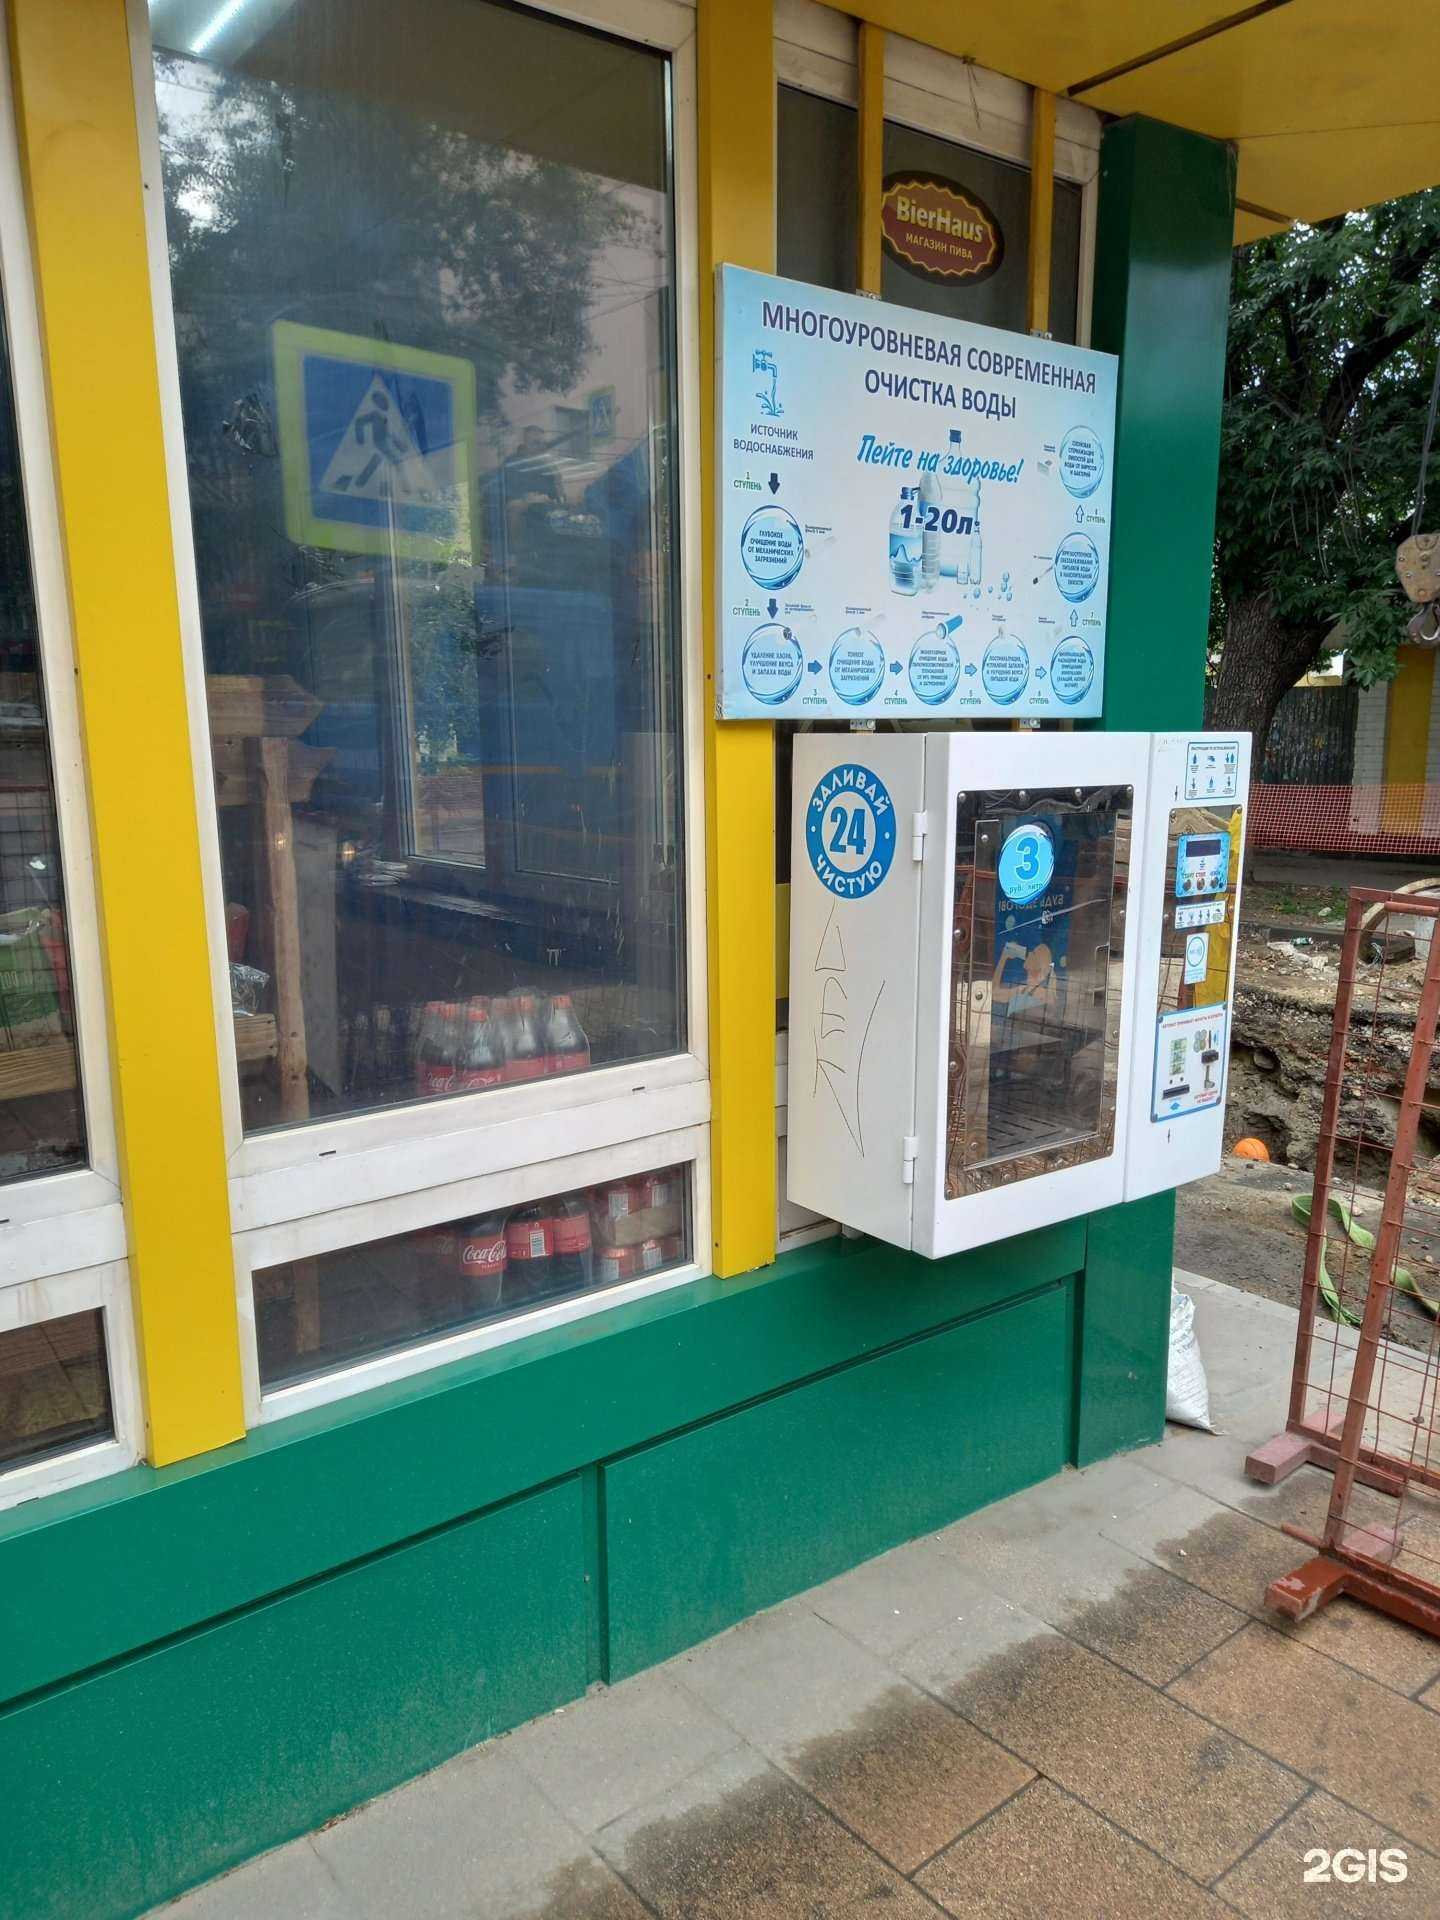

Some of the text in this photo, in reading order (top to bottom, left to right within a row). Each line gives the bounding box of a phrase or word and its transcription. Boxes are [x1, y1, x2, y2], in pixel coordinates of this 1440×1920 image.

[896, 196, 984, 243] BierHaus
[905, 233, 973, 259] МАГАЗИН ПИВА
[762, 301, 1097, 395] МНОГОУРОВНЕВАЯ СОВРЕМЕННАЯ
[864, 369, 1016, 421] ОЧИСТКА ВОДЫ
[750, 423, 798, 440] ИСТОЧНИК
[733, 438, 814, 460] ВОДОСНАБЖЕНИЯ
[856, 434, 1025, 485] Пейте на здоровье!
[733, 480, 762, 491] СТУПЕНЬ
[745, 471, 751, 480] 1
[732, 607, 761, 617] СТУПЕНЬ
[802, 697, 828, 705] СТУПЕНЬ
[884, 697, 908, 705] СТУПЕНЬ
[812, 768, 890, 816] ЗАЛИВАЙ
[829, 806, 867, 855] 24
[816, 853, 883, 894] ЧИСТУЮ
[1015, 837, 1040, 881] 3
